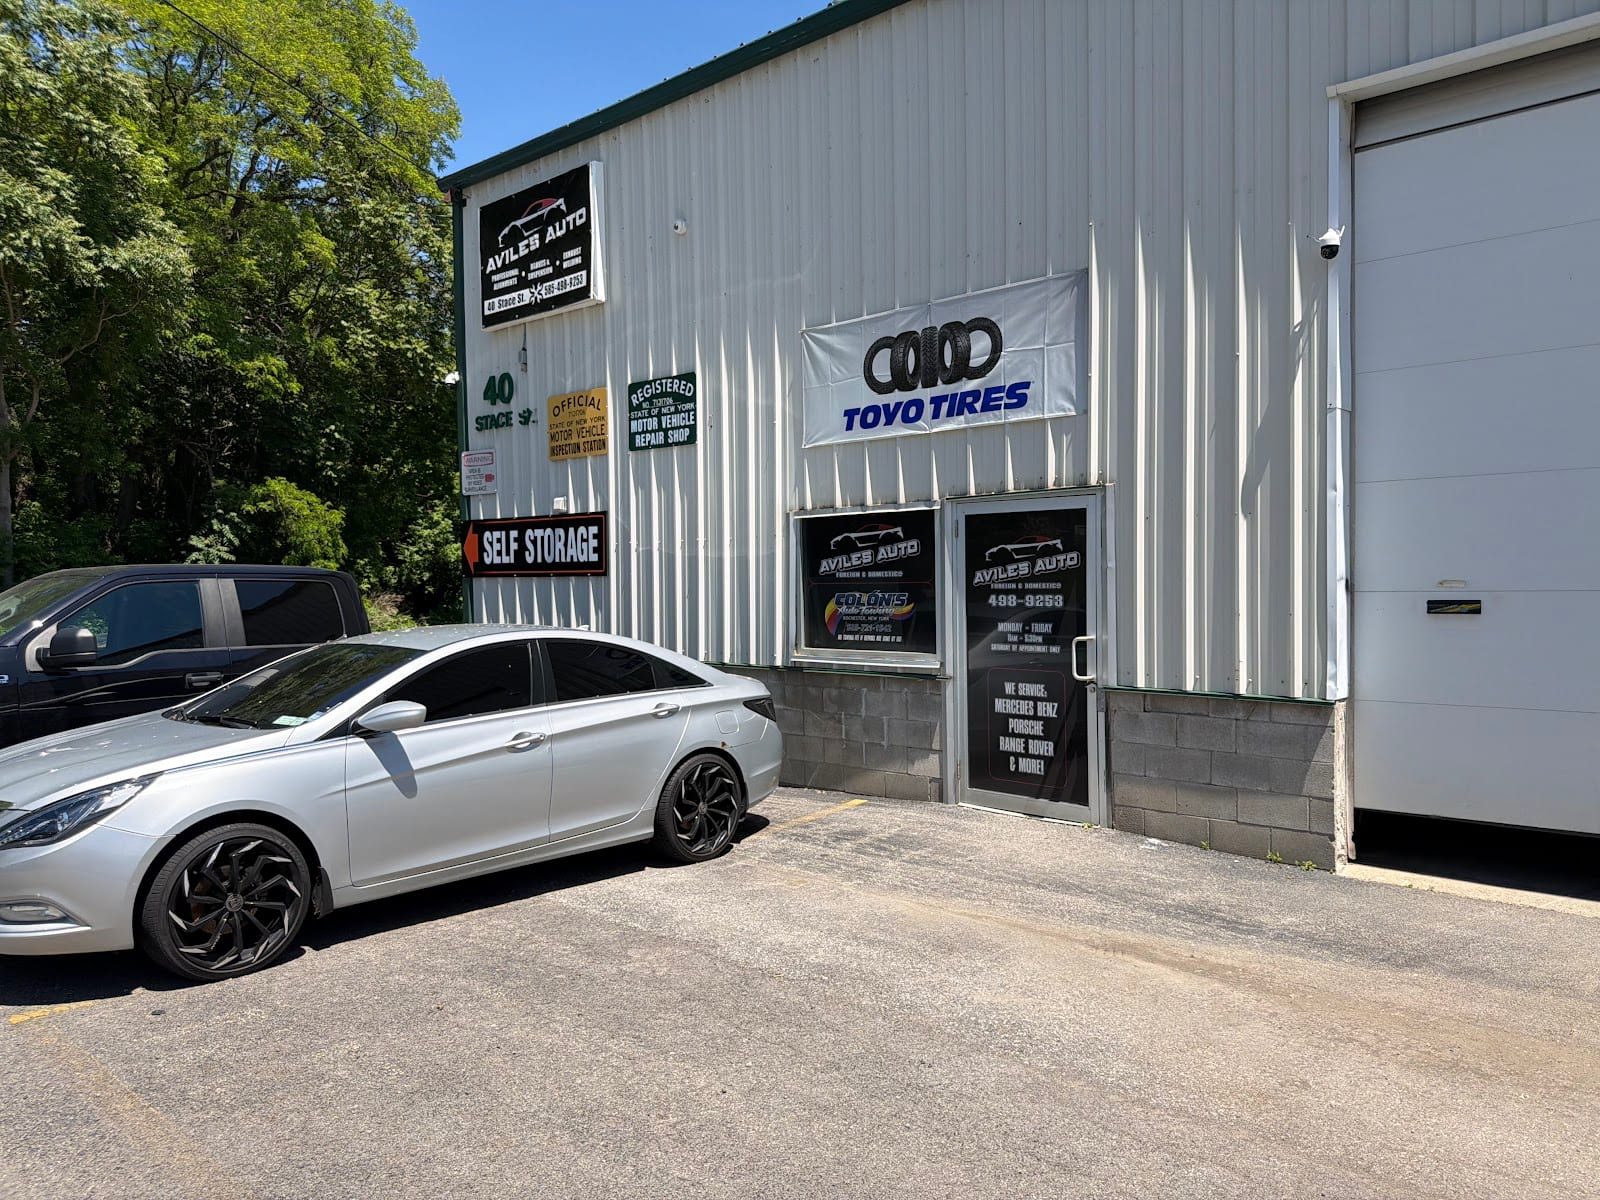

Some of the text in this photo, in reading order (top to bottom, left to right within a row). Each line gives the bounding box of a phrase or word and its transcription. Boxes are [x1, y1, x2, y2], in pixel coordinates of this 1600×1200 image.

[486, 207, 586, 274] AVILES AUTO
[487, 299, 496, 312] 40
[498, 294, 516, 309] Stace
[483, 372, 514, 406] 40
[631, 378, 694, 407] REGISTERED
[552, 394, 601, 417] OFFICIAL
[630, 402, 695, 419] STATE OF NEW YORK
[843, 381, 1031, 432] TOYO TIRES
[475, 411, 514, 432] STACE
[549, 415, 606, 431] STATE OF NEW YORK
[630, 411, 695, 433] MOTOR VEHICLE
[550, 423, 605, 443] MOTOR VEHICLE
[635, 427, 690, 447] REPAIR SHOP
[551, 438, 606, 457] INSPECTION STATION
[483, 526, 599, 565] SELF STORAGE
[819, 539, 921, 575] AVILES AUTO
[973, 551, 1081, 587] AVILES AUTO
[837, 605, 896, 615] Auto Towing
[988, 594, 1064, 608] 498-9253
[997, 622, 1023, 633] MONDAY
[1031, 623, 1053, 633] FRIDAY
[1004, 681, 1016, 695] WE
[994, 698, 1058, 718] MERCEDES BENZ
[1008, 718, 1044, 736] PORSCHE
[999, 736, 1054, 757] RANGE ROVER
[1009, 756, 1045, 775] & MORE!
